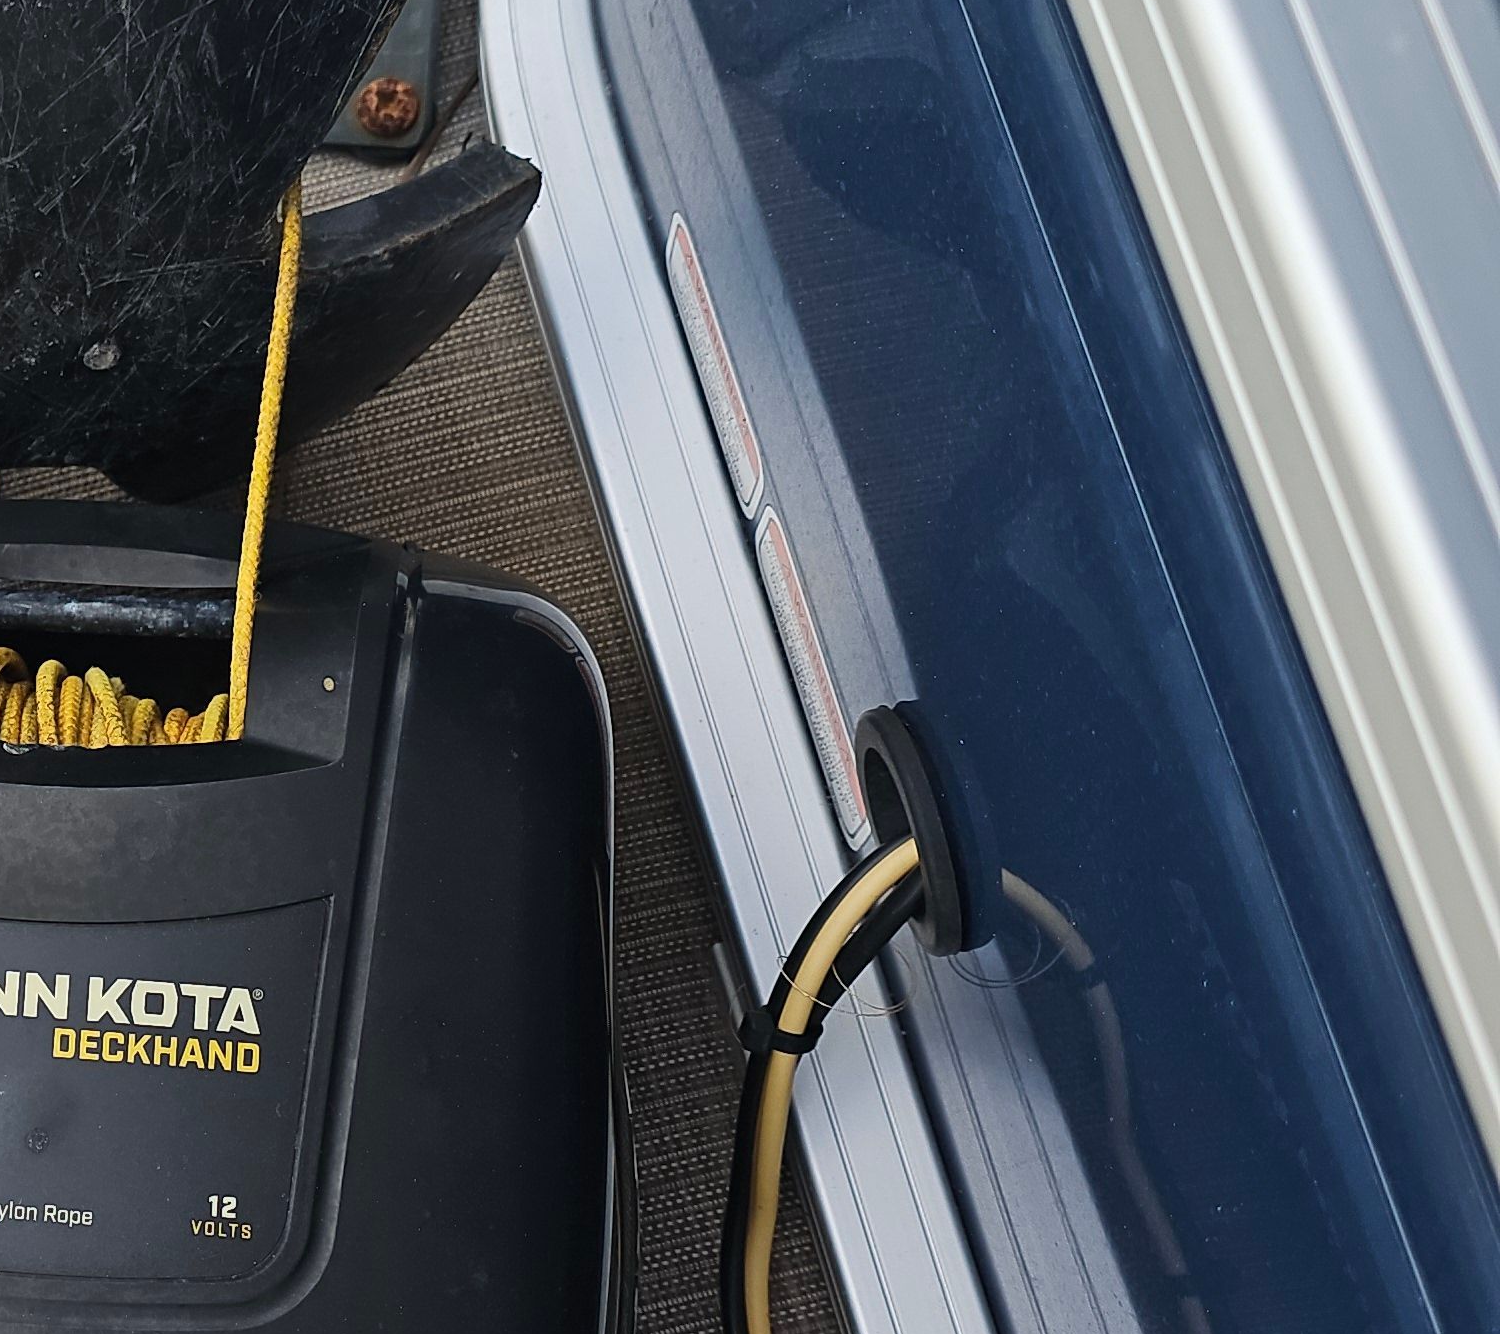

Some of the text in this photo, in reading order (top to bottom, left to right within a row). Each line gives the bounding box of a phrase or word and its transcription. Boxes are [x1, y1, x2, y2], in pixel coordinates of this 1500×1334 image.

[52, 1027, 260, 1073] DECKHAND
[43, 1204, 93, 1228] Rope
[207, 1195, 237, 1219] 12
[191, 1219, 252, 1239] VOLTS
